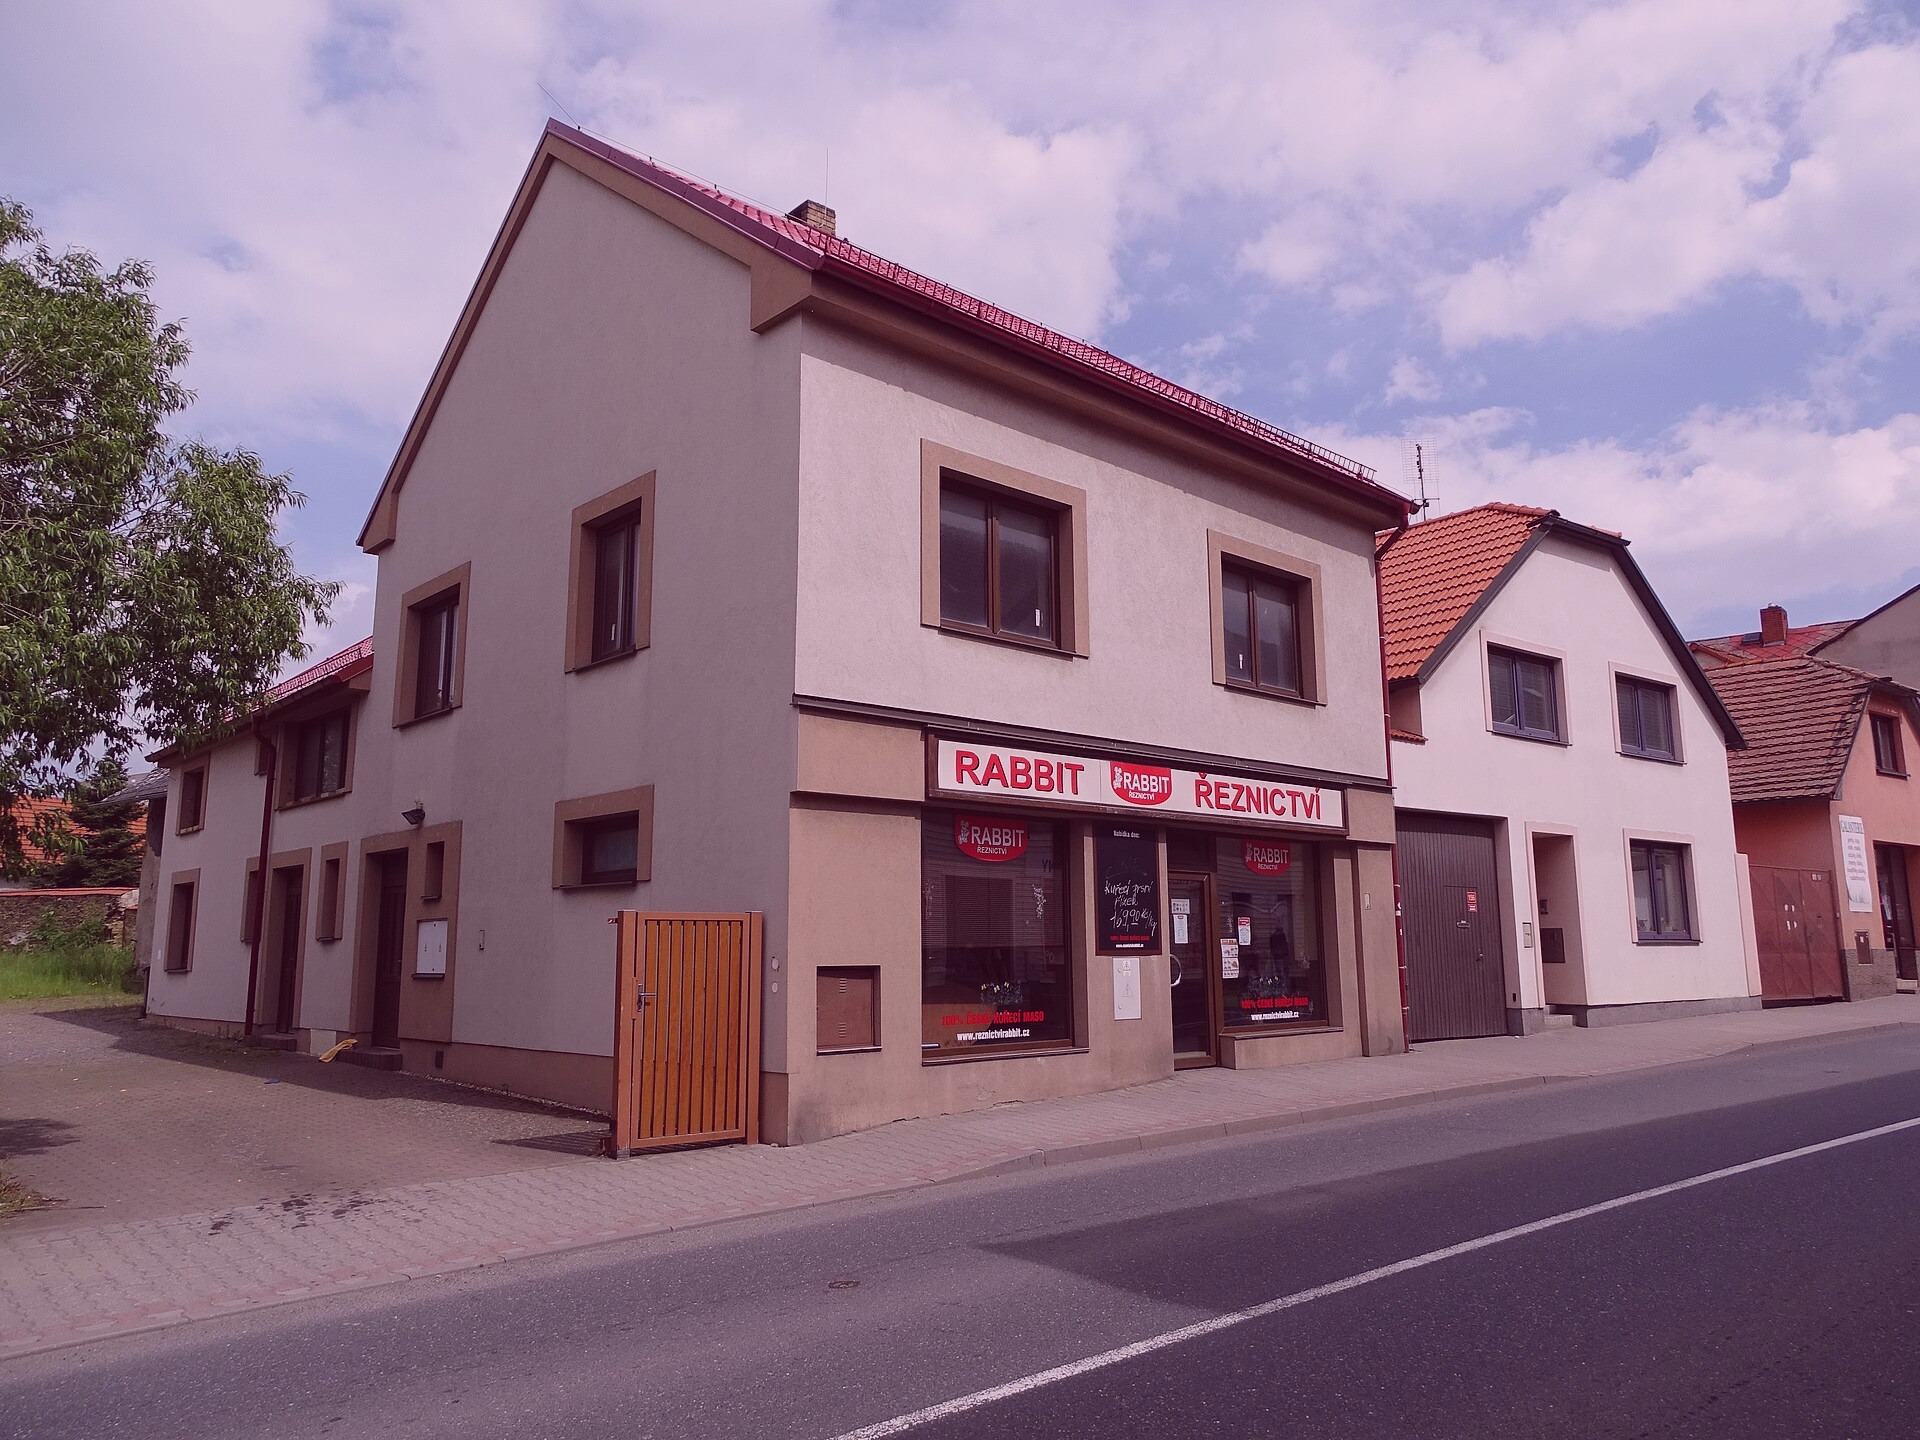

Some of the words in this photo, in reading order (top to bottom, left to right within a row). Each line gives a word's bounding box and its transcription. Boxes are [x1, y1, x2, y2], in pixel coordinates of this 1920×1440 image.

[955, 750, 1085, 795] RABBIT
[1123, 771, 1170, 794] RABBIT
[1128, 789, 1155, 801] ŘEZNICTVÍ
[1194, 771, 1321, 820] ŘEZNICTVÍ
[971, 825, 1025, 848] RABBIT
[976, 846, 1008, 856] ŘEZNICTVÍ
[1253, 847, 1289, 864] RABBIT
[942, 1015, 963, 1026] 100%
[1023, 1011, 1045, 1023] MASO
[957, 1027, 1030, 1041] www.reznictvirabbit.cz
